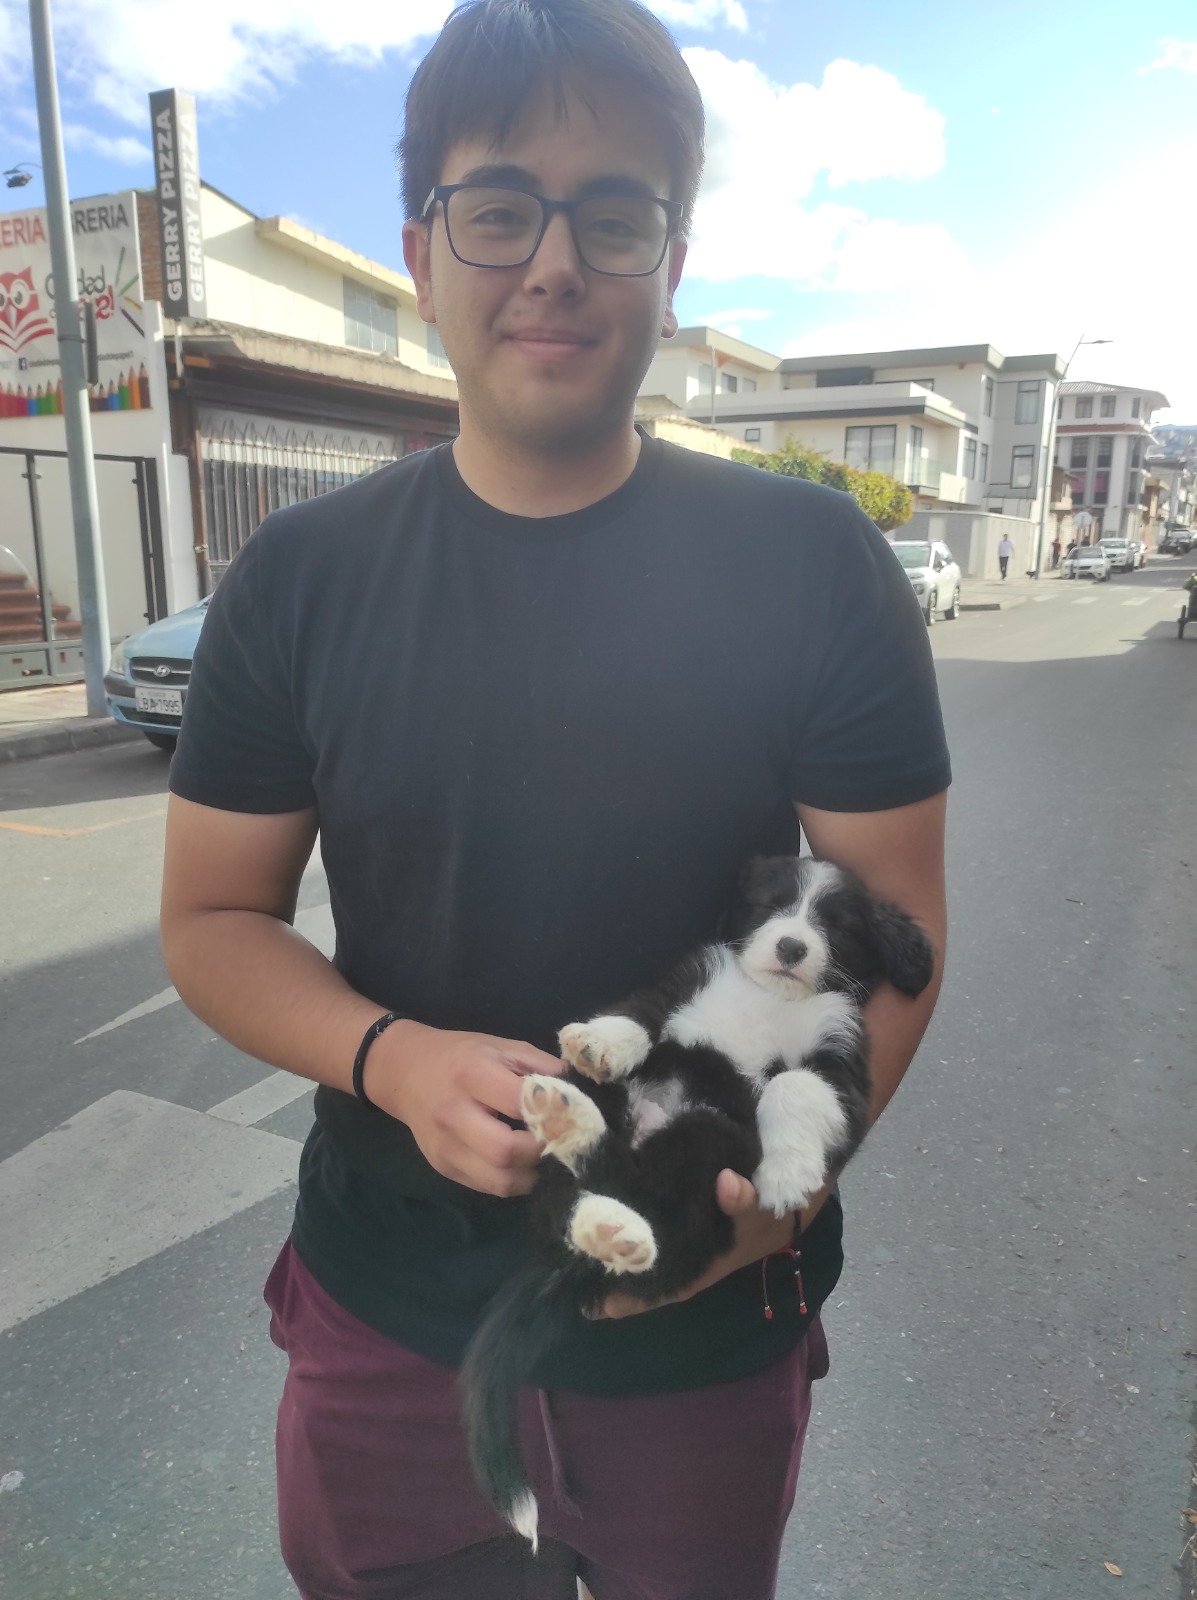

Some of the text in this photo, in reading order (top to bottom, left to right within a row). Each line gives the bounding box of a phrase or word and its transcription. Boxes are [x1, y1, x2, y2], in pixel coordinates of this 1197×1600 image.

[0, 214, 46, 248] ERIA
[156, 107, 183, 301] GERRY PIZZA
[180, 114, 204, 302] GERRY PIZZA
